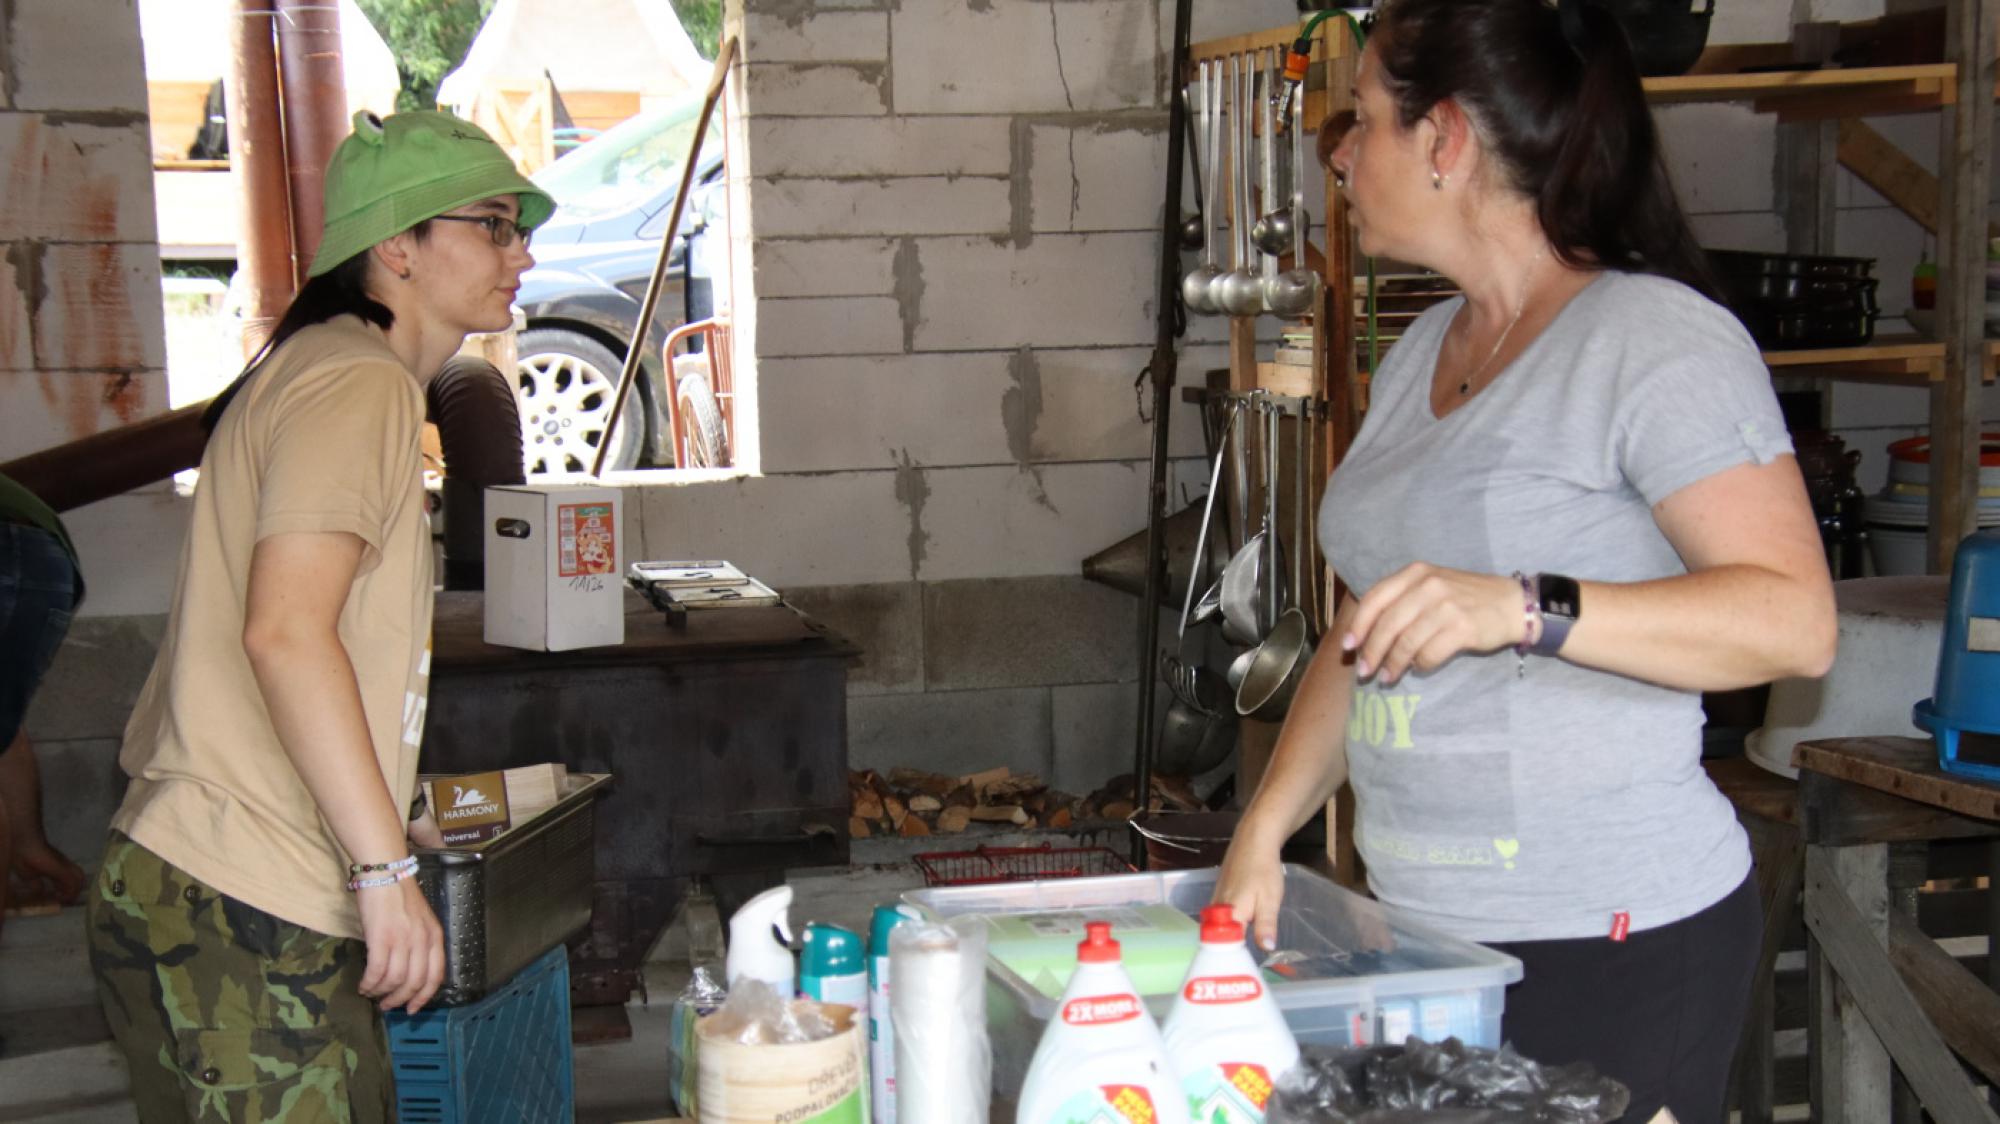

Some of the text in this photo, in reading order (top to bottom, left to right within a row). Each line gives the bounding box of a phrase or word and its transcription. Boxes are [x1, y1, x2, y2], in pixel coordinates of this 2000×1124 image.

[443, 803, 500, 821] HARMONY
[1193, 981, 1216, 1000] 2X
[1068, 1002, 1094, 1021] 2X
